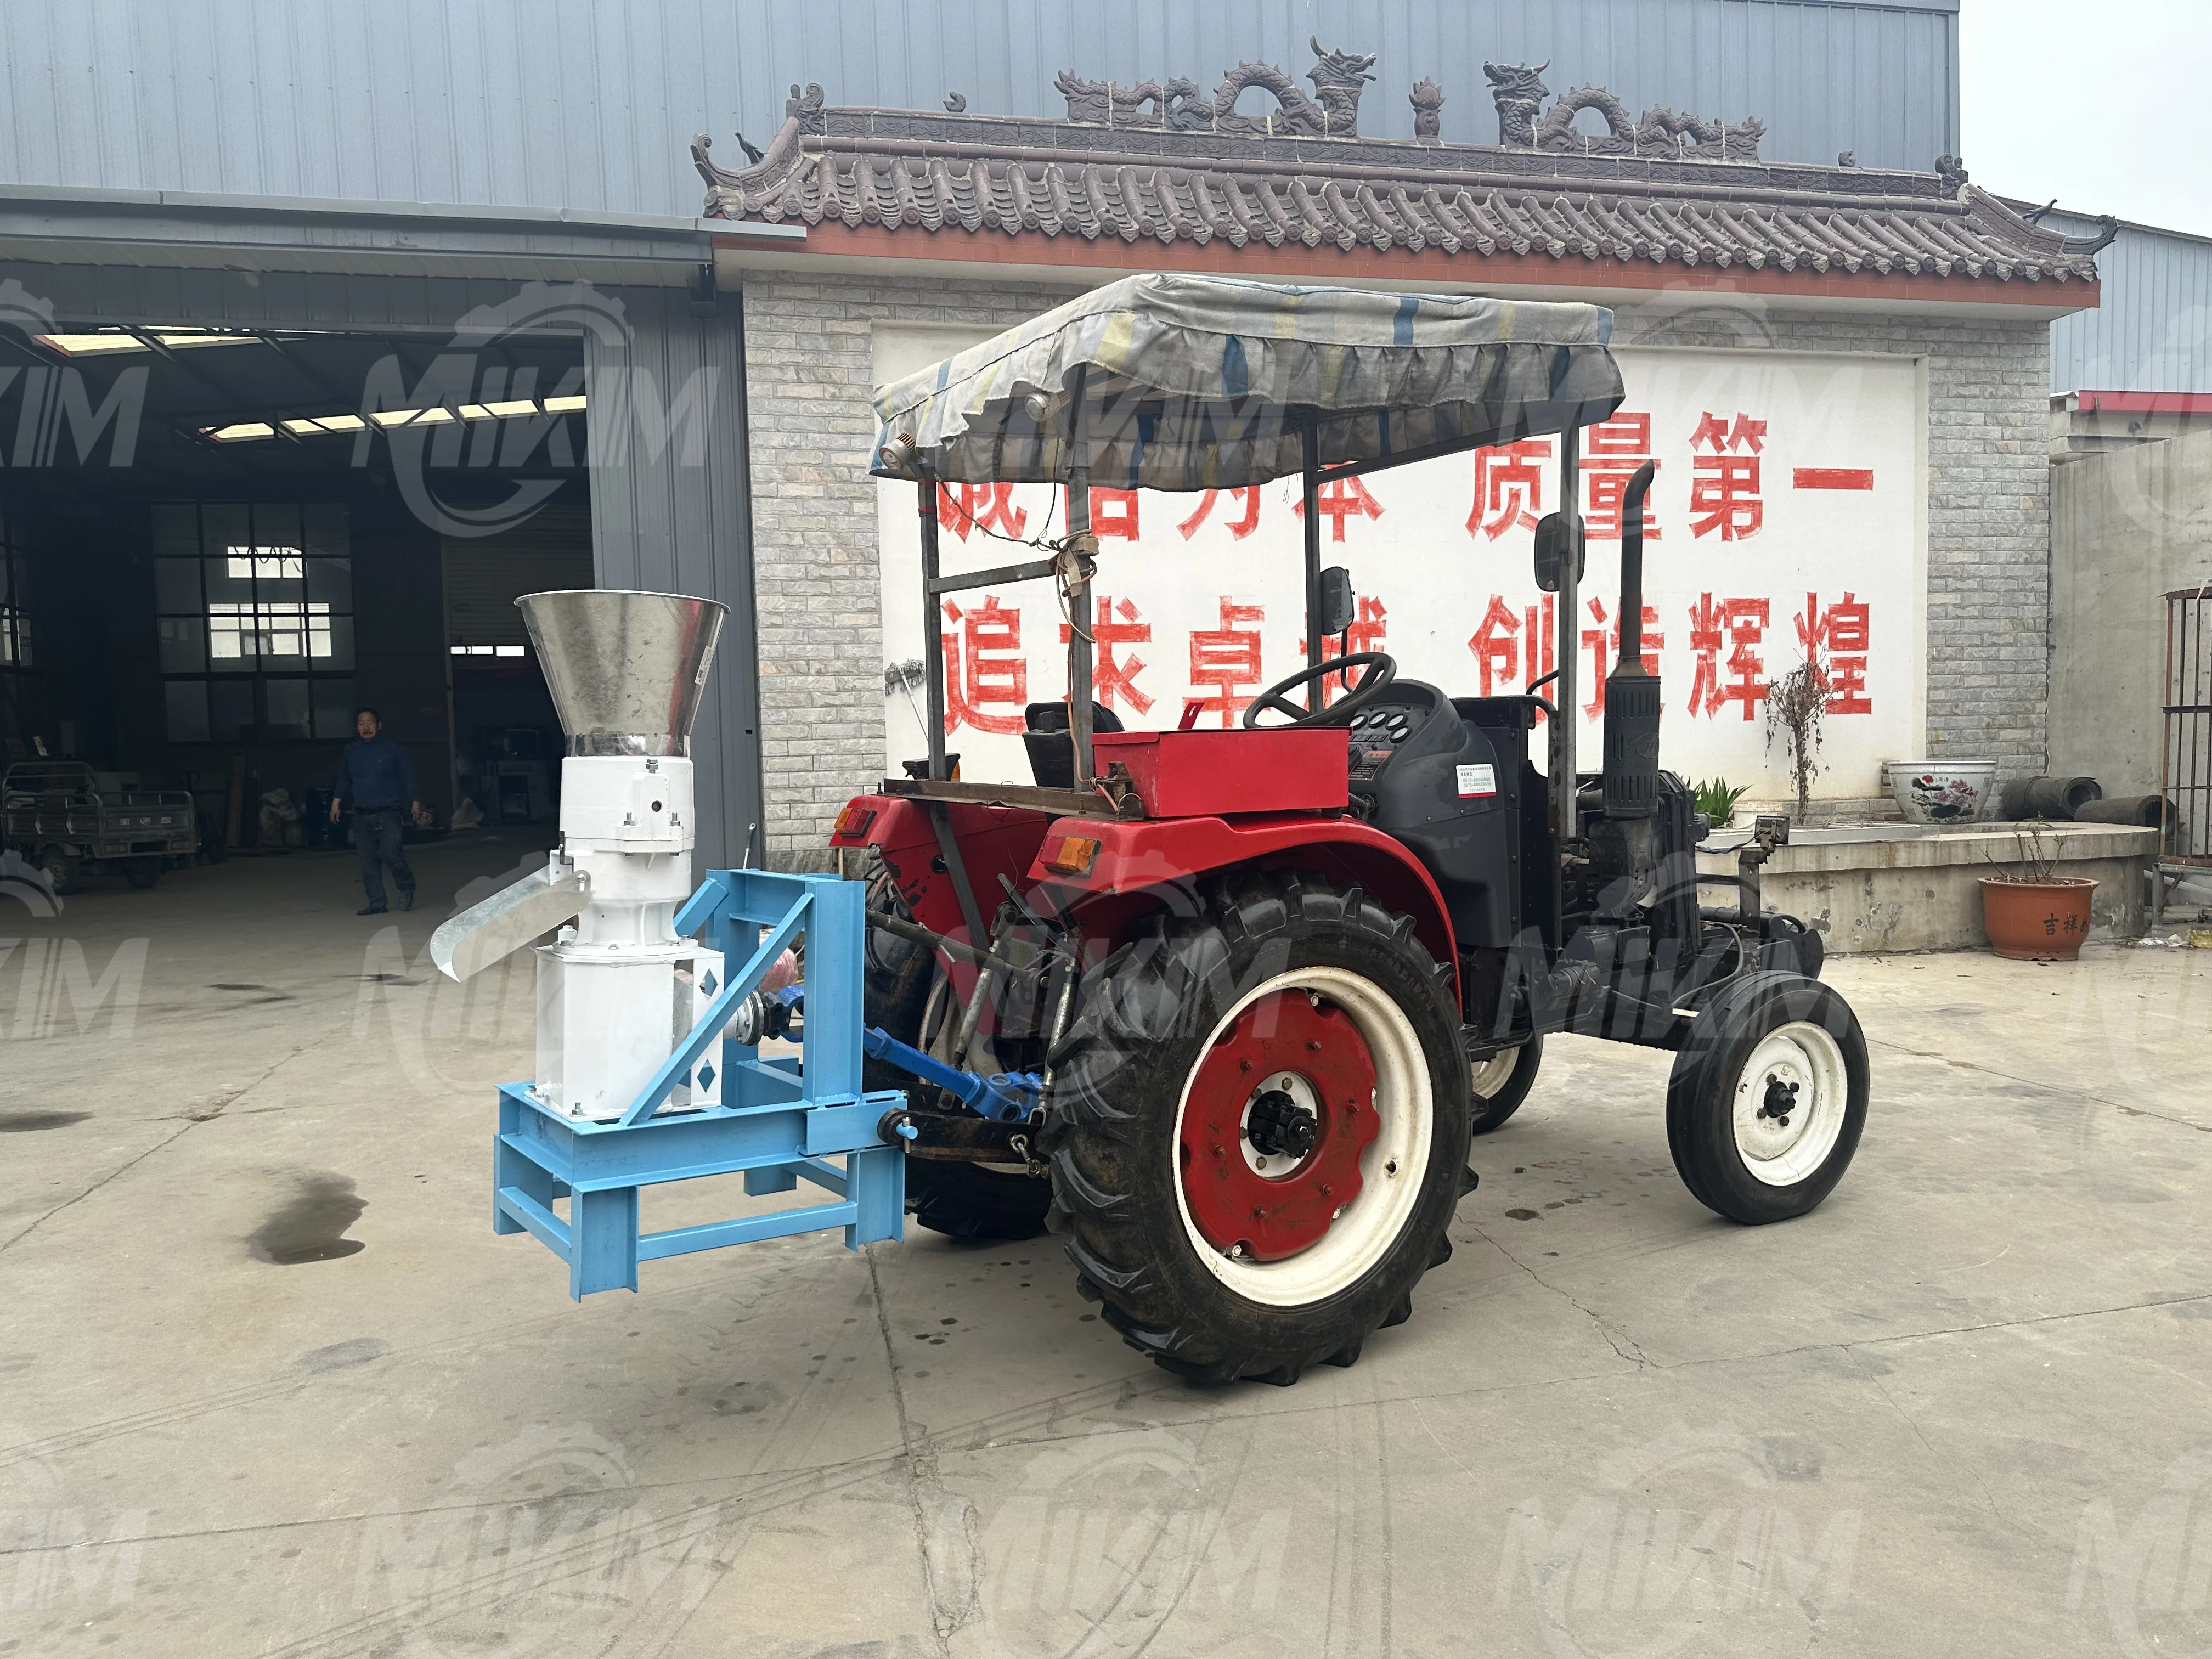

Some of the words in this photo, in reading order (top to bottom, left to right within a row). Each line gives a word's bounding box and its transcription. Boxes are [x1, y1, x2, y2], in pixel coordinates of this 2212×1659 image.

[1465, 412, 1874, 543] 质量第一
[1467, 592, 1872, 725] 创造辉煌
